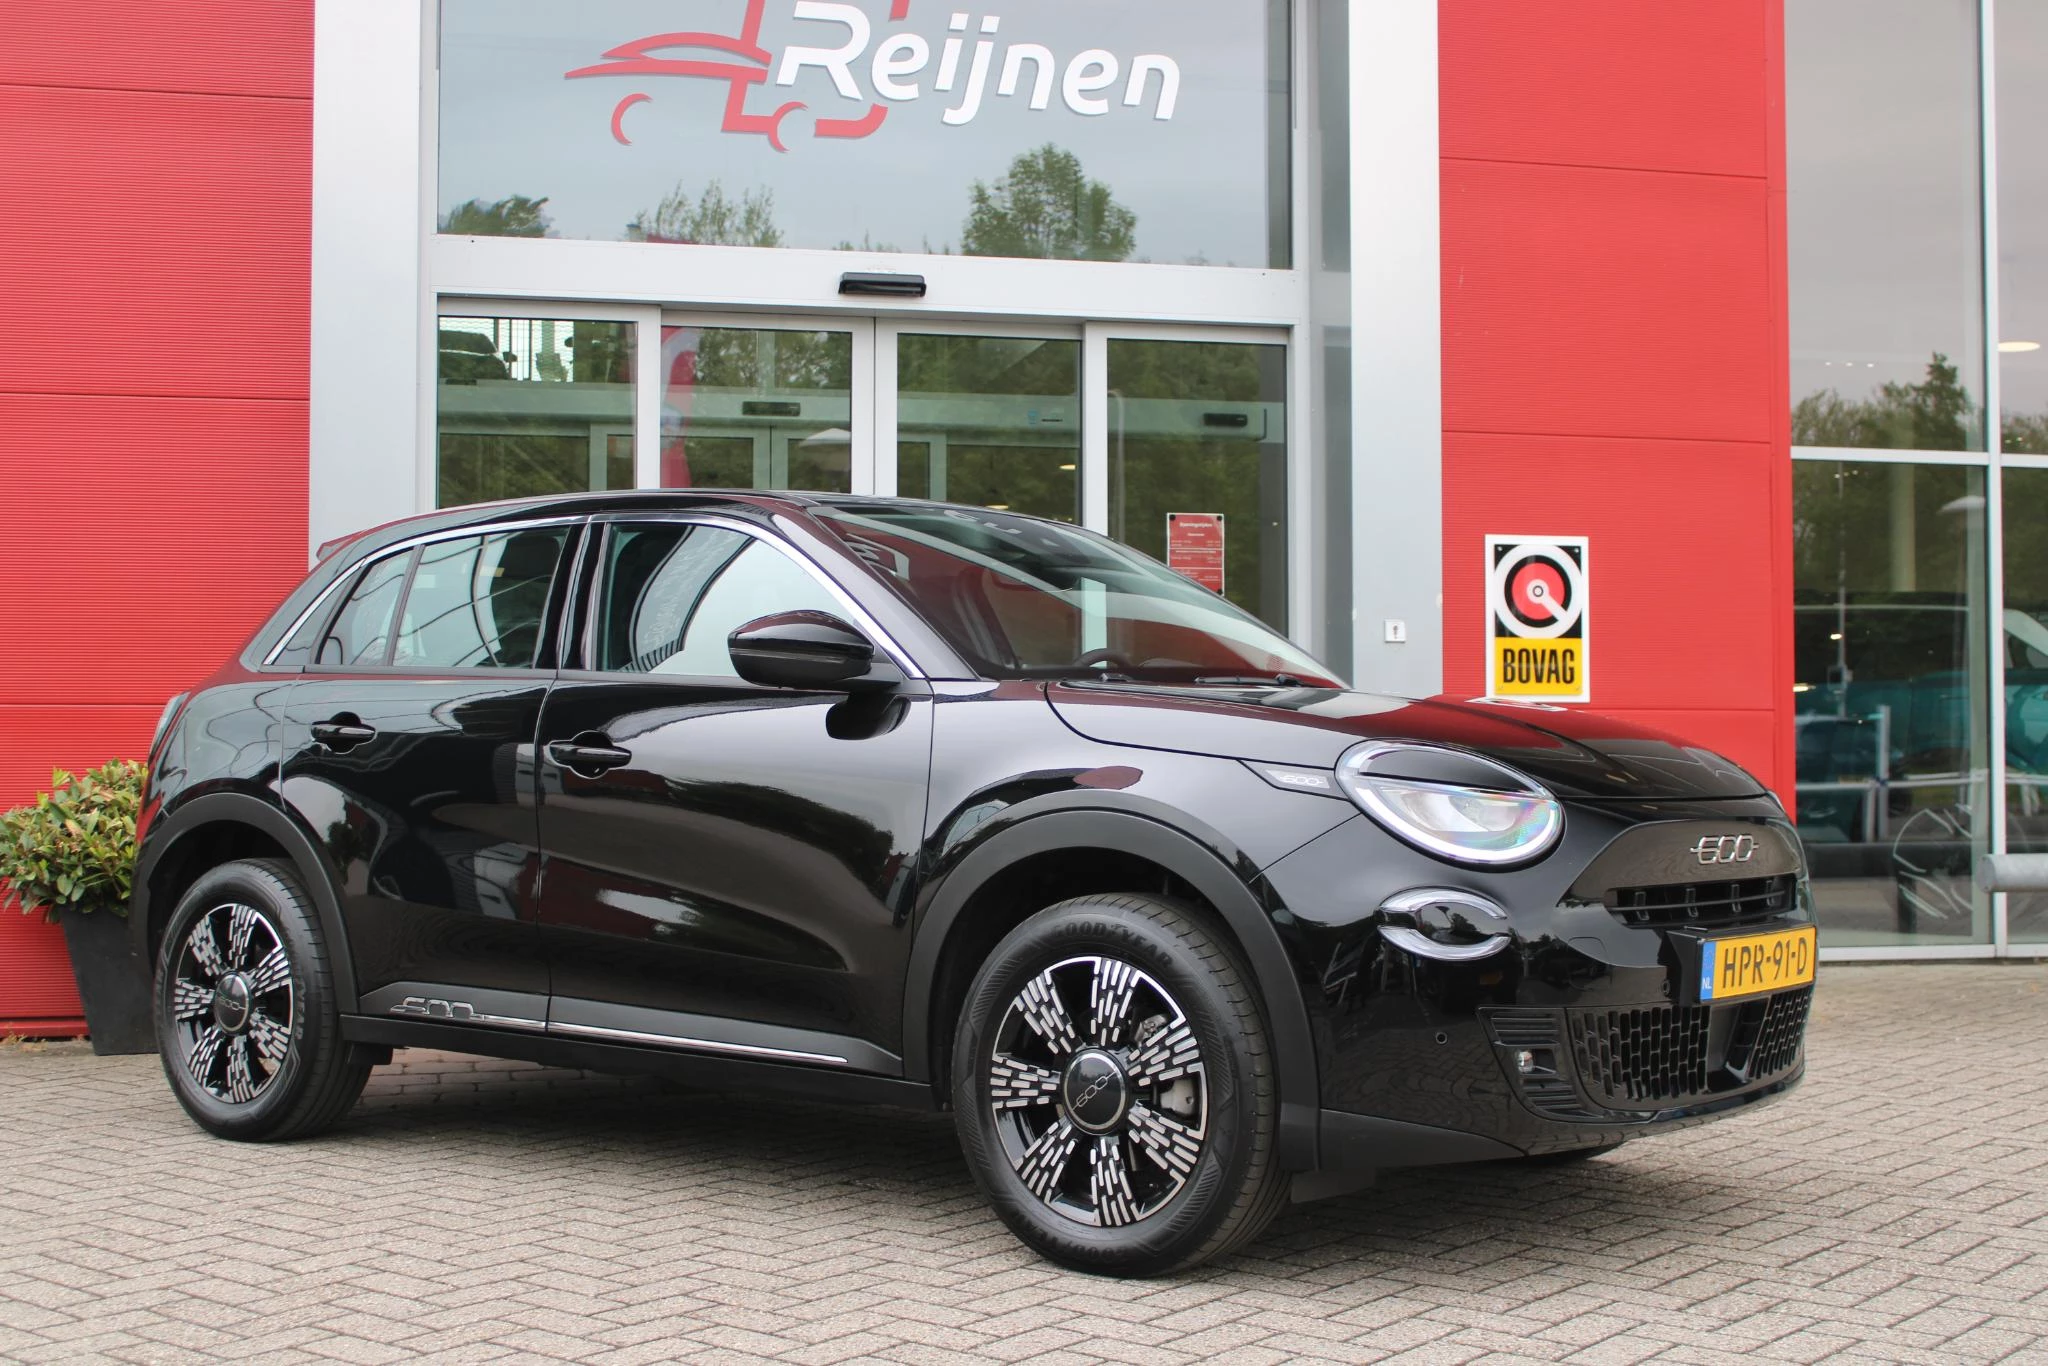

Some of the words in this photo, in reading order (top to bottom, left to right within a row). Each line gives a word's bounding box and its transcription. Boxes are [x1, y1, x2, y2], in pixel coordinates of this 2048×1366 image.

[776, 1, 1181, 126] Reijnen
[1503, 648, 1575, 684] BOVAG
[1702, 977, 1712, 989] NL
[1722, 937, 1808, 989] HPR-91-D
